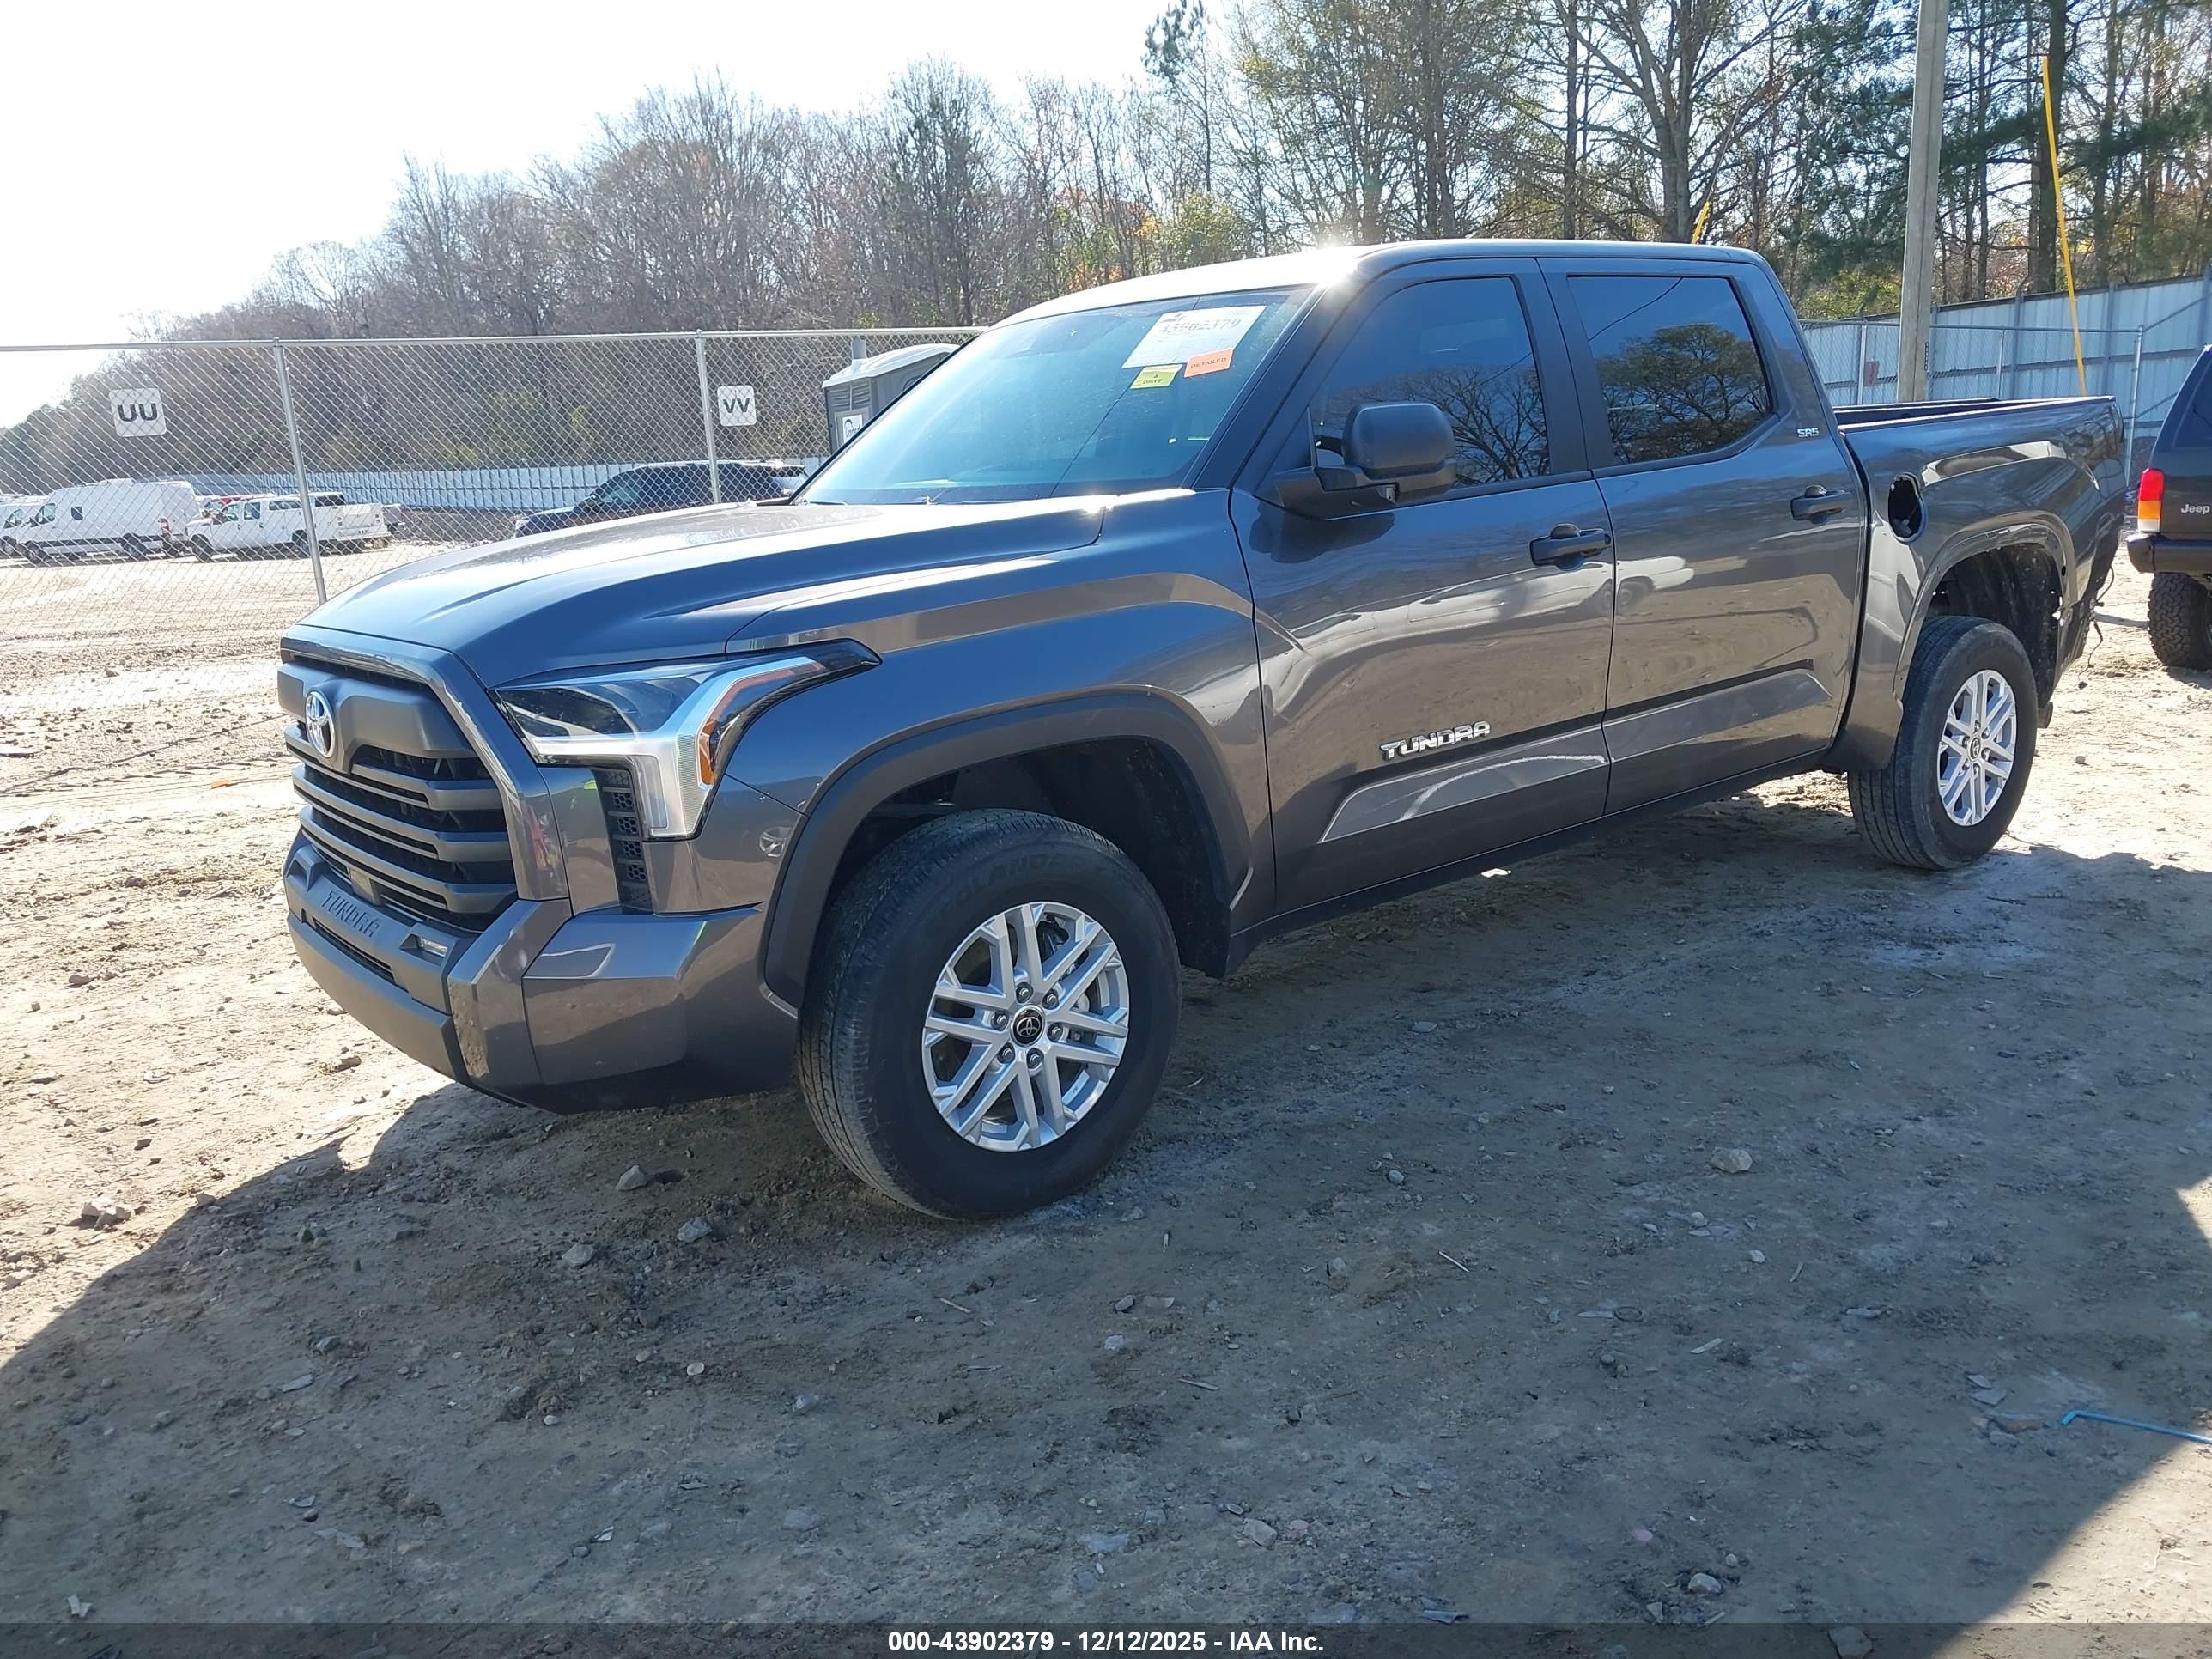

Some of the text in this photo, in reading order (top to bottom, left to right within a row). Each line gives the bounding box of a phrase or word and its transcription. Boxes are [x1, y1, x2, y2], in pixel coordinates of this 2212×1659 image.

[118, 404, 158, 422] UU
[723, 398, 750, 414] VV
[2180, 503, 2211, 515] Jeep
[1380, 720, 1491, 760] TUNDRA
[321, 890, 380, 938] TUNDRA
